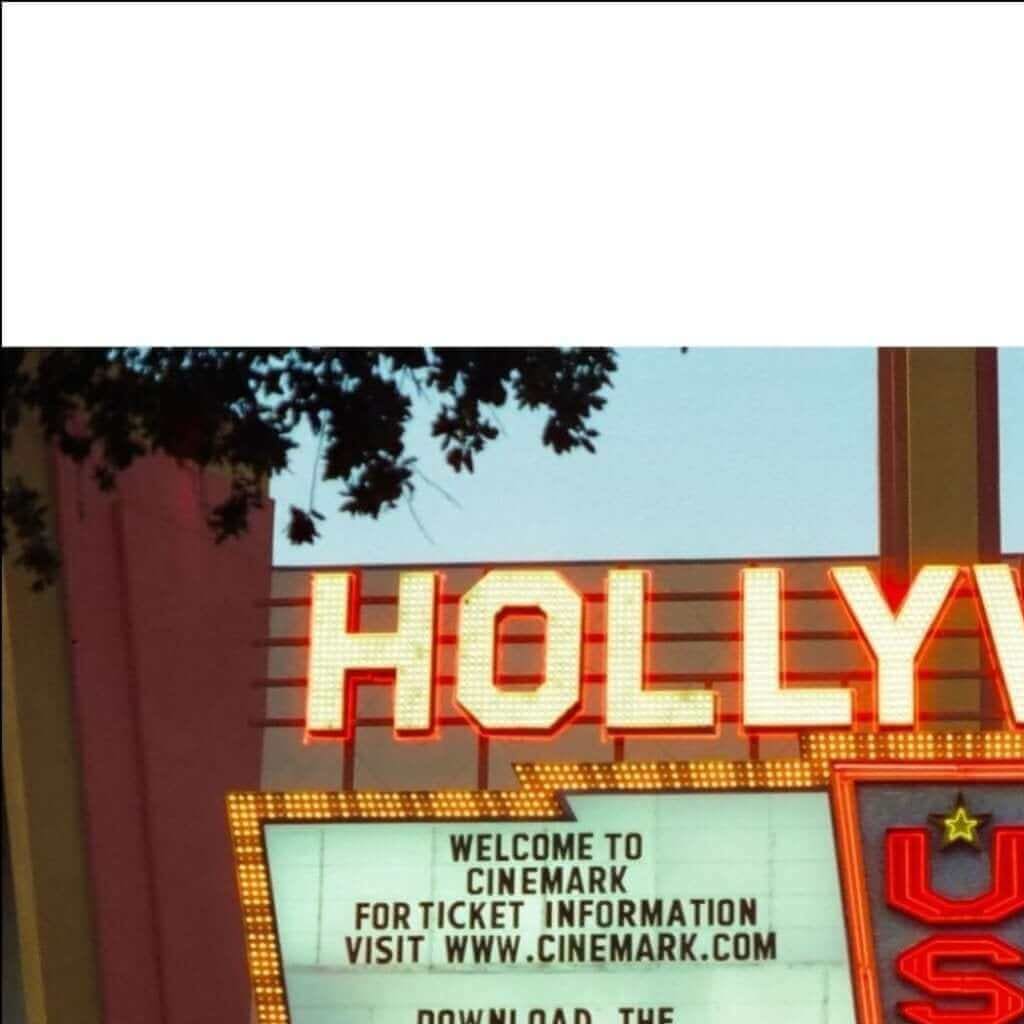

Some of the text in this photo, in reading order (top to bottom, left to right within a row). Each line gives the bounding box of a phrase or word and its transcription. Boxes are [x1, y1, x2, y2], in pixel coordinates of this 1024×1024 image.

[450, 833, 642, 862] WELCOME TO
[467, 866, 627, 896] CINEMARK
[355, 898, 757, 930] FOR TICKET INFORMATION
[345, 936, 425, 965] VISIT
